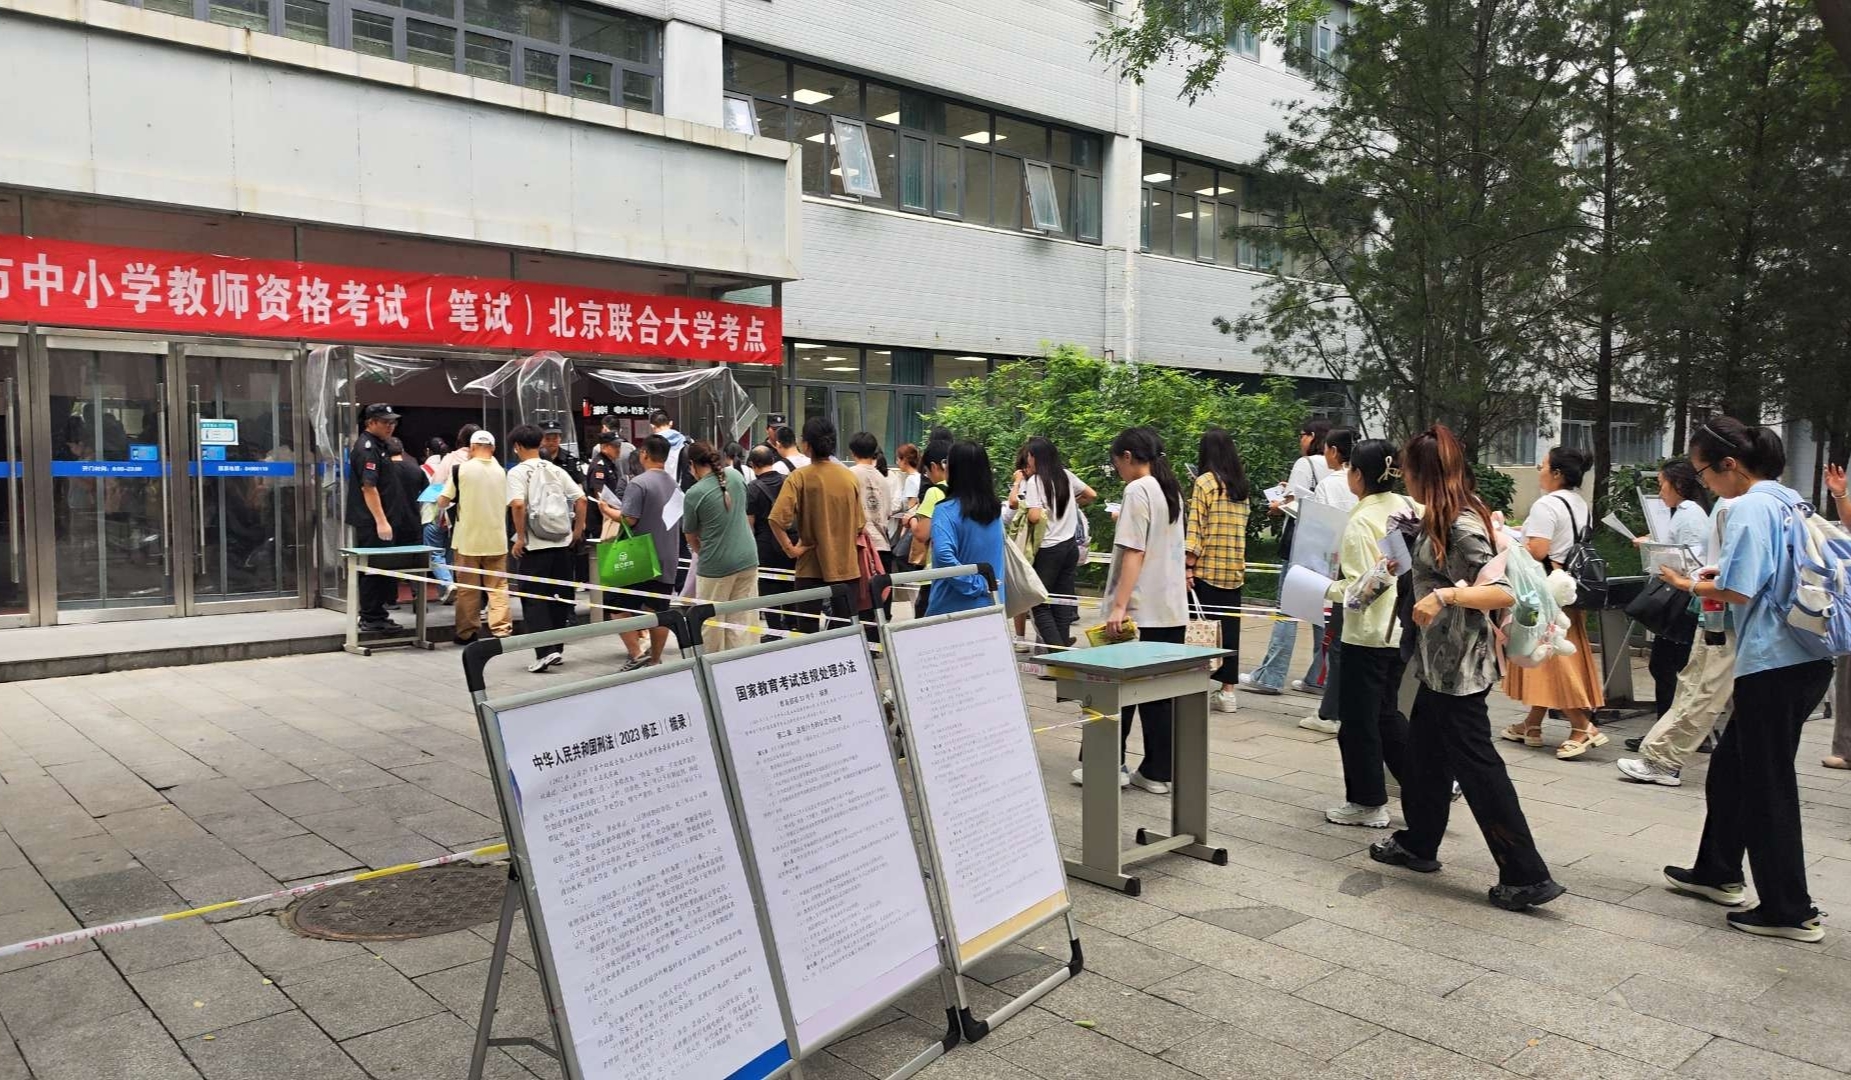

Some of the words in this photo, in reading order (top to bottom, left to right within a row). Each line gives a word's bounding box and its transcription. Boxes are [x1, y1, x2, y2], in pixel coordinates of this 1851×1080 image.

[735, 660, 858, 702] 国家教育考试违规处理办法
